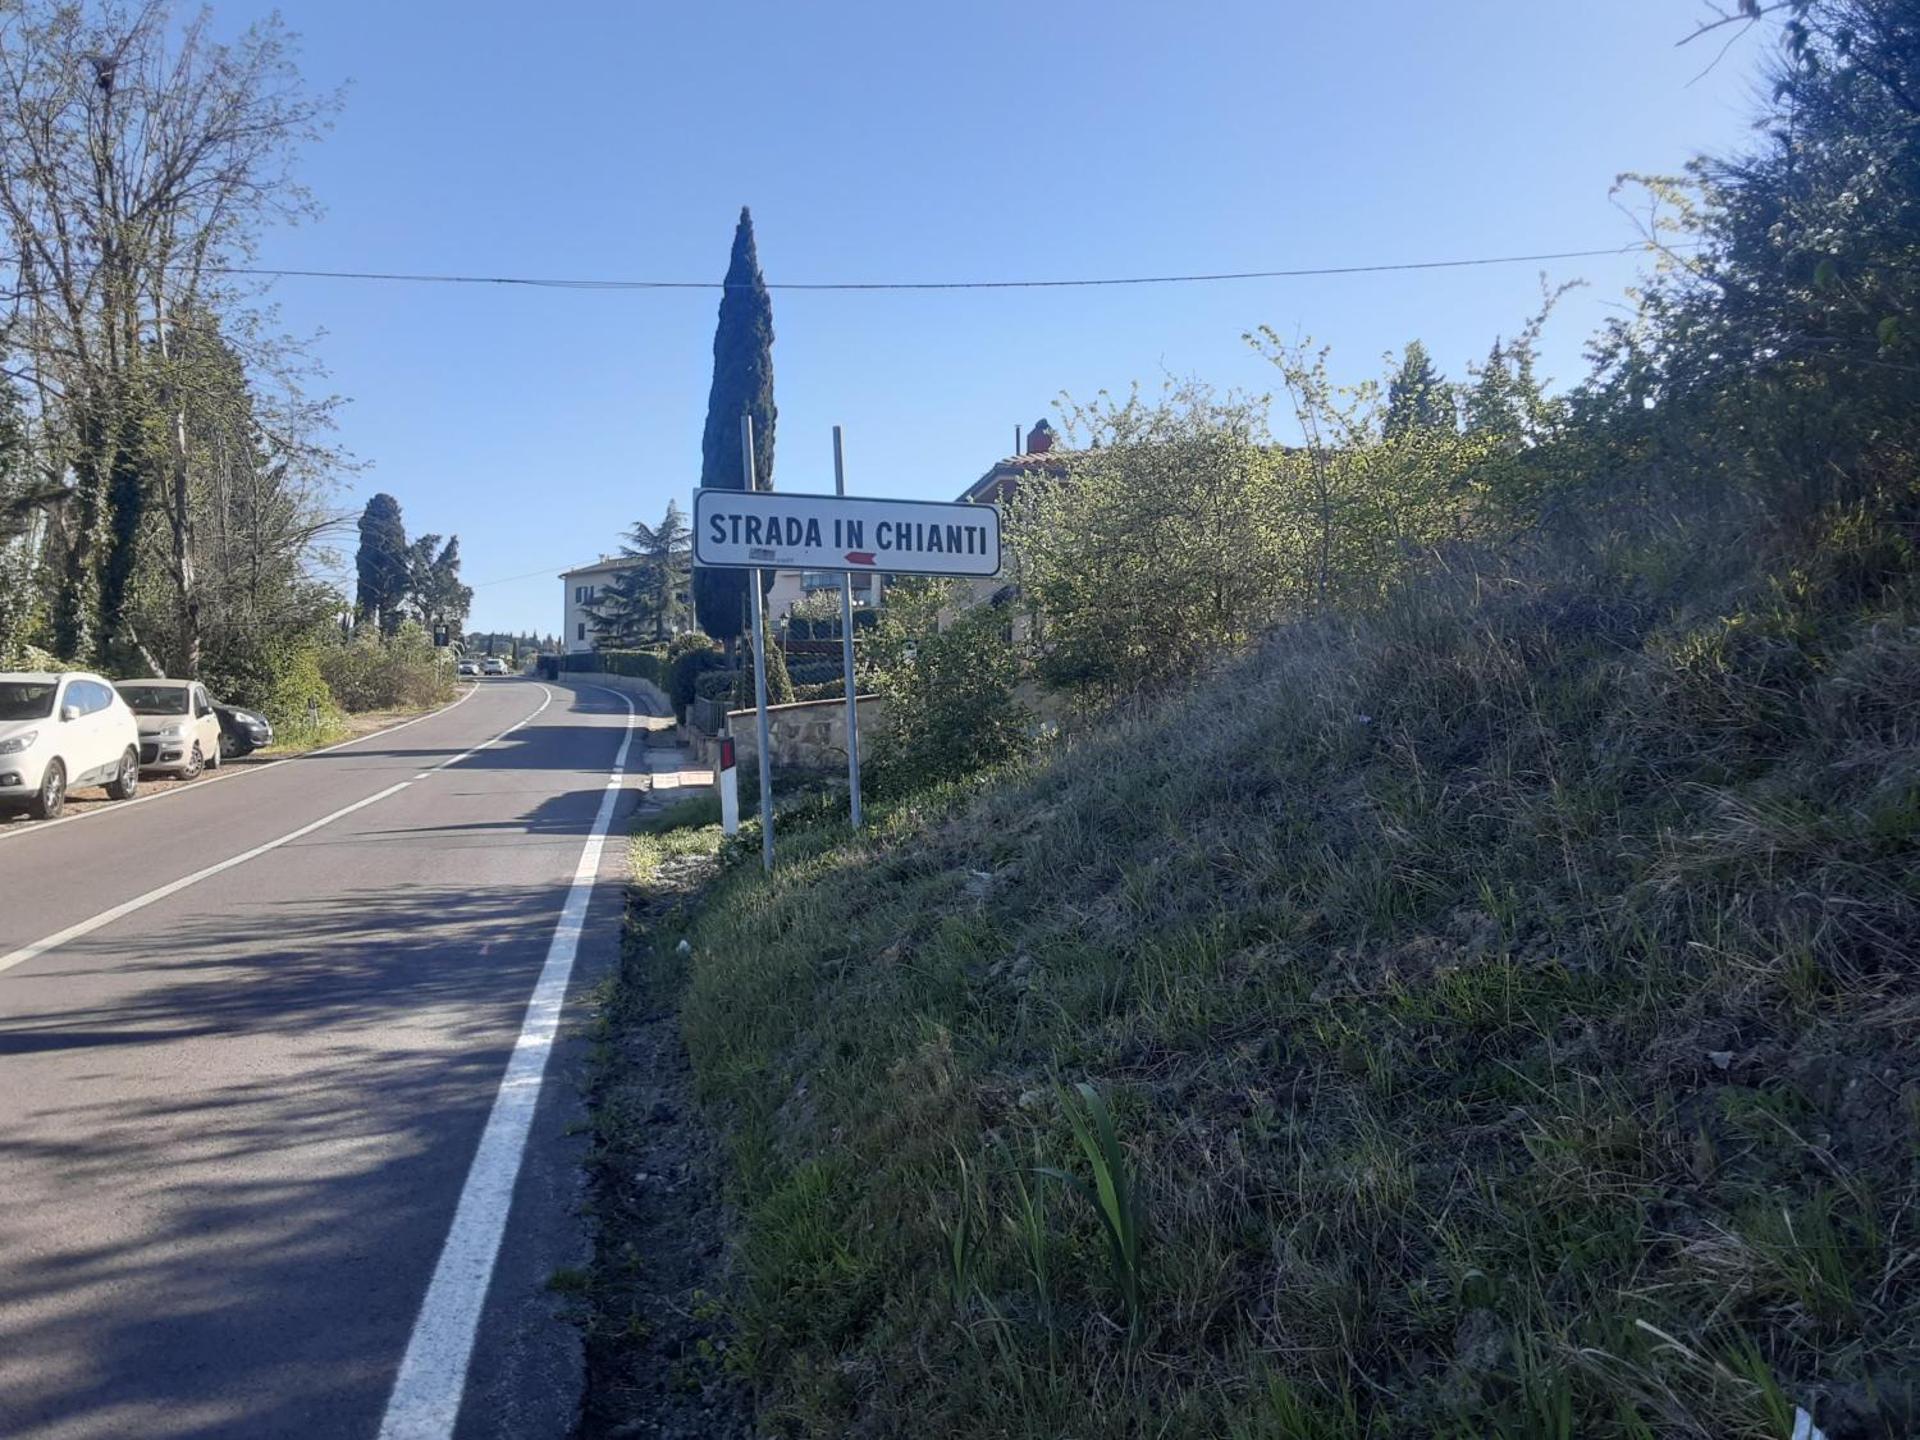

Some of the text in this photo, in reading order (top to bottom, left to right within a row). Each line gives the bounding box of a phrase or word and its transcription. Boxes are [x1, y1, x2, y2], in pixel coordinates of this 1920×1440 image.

[710, 513, 987, 555] STRADA IN CHIANTI
